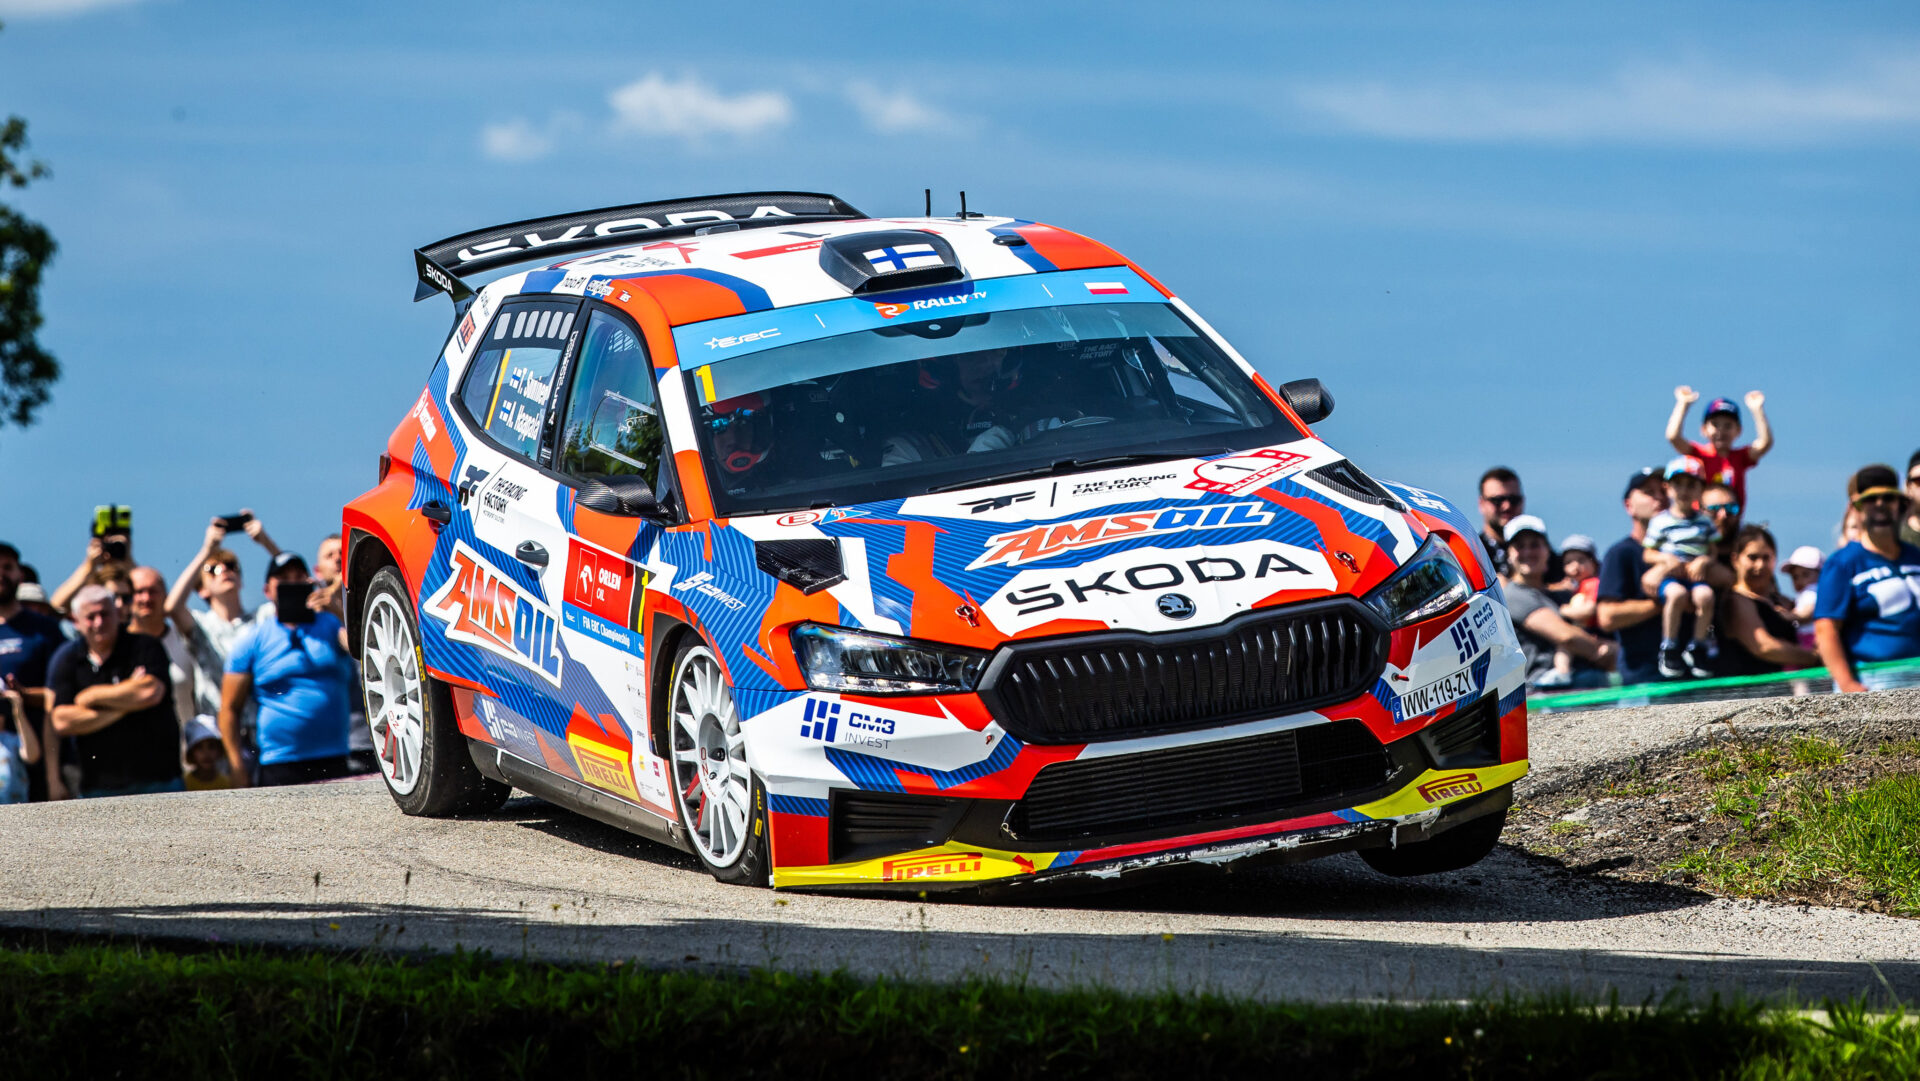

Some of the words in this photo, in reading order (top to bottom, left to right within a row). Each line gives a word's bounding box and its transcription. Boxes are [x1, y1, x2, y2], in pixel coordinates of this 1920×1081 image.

[425, 263, 454, 295] SKODA
[695, 363, 717, 403] 1
[492, 477, 511, 493] THE
[505, 481, 528, 501] RACING
[1072, 481, 1152, 494] FACTORY
[1074, 481, 1108, 489] THE
[1113, 474, 1177, 484] RACING
[484, 491, 509, 514] FACTORY
[980, 503, 1272, 565] AMSOIL
[598, 567, 622, 591] ORLEN
[1005, 553, 1314, 617] SKODA
[596, 587, 606, 602] OIL
[434, 547, 561, 681] AMSOIL
[1472, 602, 1494, 630] CM3
[582, 615, 592, 630] FIA
[590, 618, 601, 635] ERC
[600, 623, 631, 649] Championship
[1479, 620, 1499, 644] INVEST
[1402, 669, 1472, 717] WW-119-ZY
[848, 712, 895, 735] CM3
[844, 731, 891, 750] INVEST
[574, 744, 631, 792] PIRELLI
[1416, 773, 1483, 804] PIRELLI
[883, 851, 983, 882] PIRELLI
